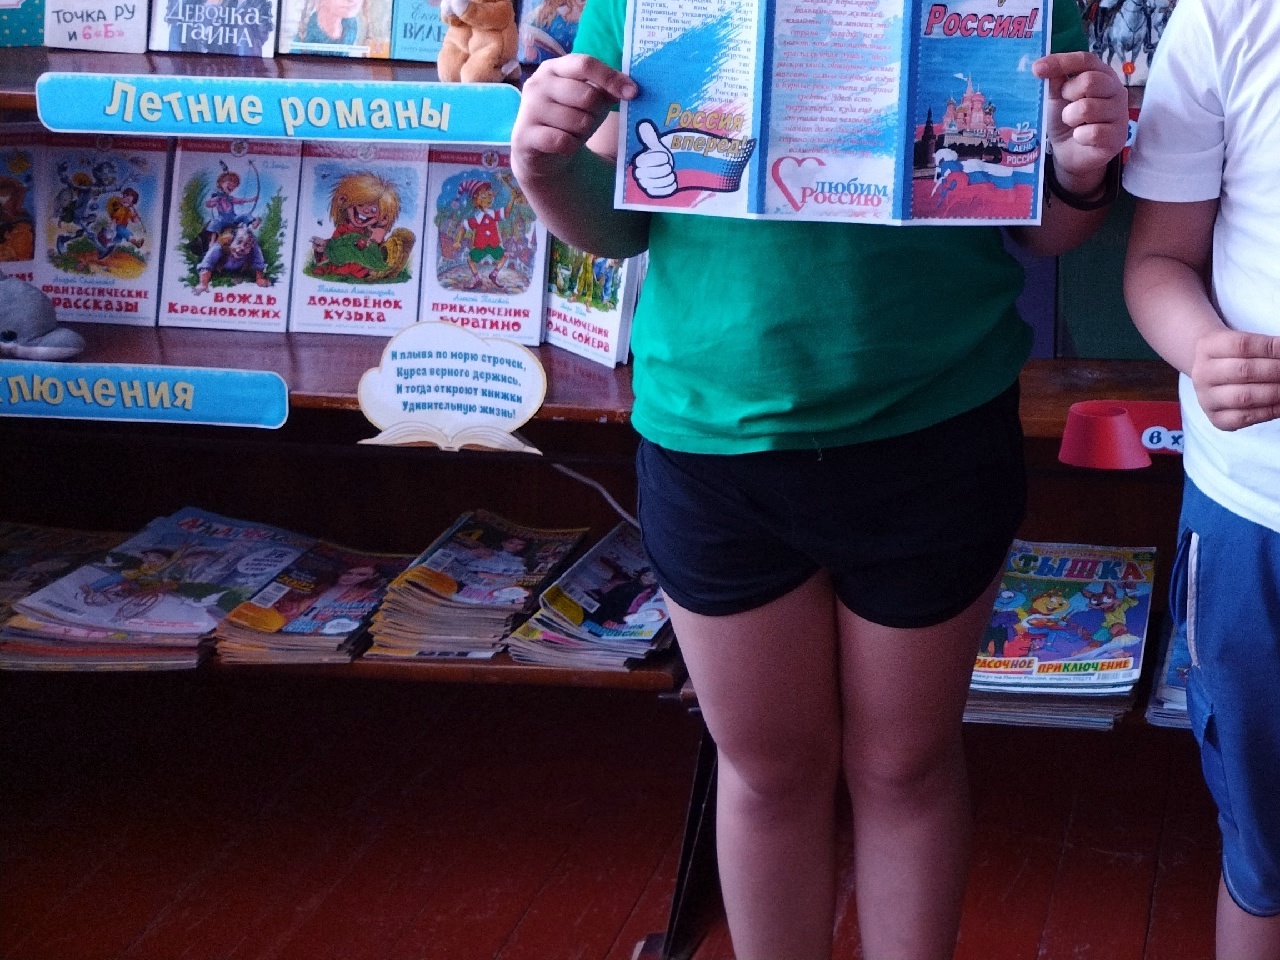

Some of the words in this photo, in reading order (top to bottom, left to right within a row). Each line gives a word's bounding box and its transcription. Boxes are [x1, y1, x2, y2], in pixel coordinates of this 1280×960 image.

[52, 9, 108, 25] ТОЧКА
[114, 3, 137, 21] РУ
[104, 80, 263, 125] Летние
[280, 93, 452, 137] романы
[664, 102, 745, 133] Россия
[1006, 150, 1038, 165] РОССИИ
[800, 187, 883, 208] Россию
[815, 178, 889, 198] любим
[400, 350, 433, 361] плывя
[436, 351, 448, 361] по
[450, 351, 478, 363] морю
[481, 353, 527, 372] строчек,
[396, 367, 427, 380] Курса
[429, 368, 470, 381] верного
[0, 374, 195, 411] лючения
[405, 384, 432, 395] тогда
[434, 385, 478, 397] откроют
[481, 387, 523, 404] книжки
[402, 400, 477, 415] Удивительную
[479, 404, 516, 419] жизнь!
[974, 658, 1035, 670] РАСОЧНОЕ
[1037, 658, 1131, 674] ПРИКЛЮЧЕНИЕ
